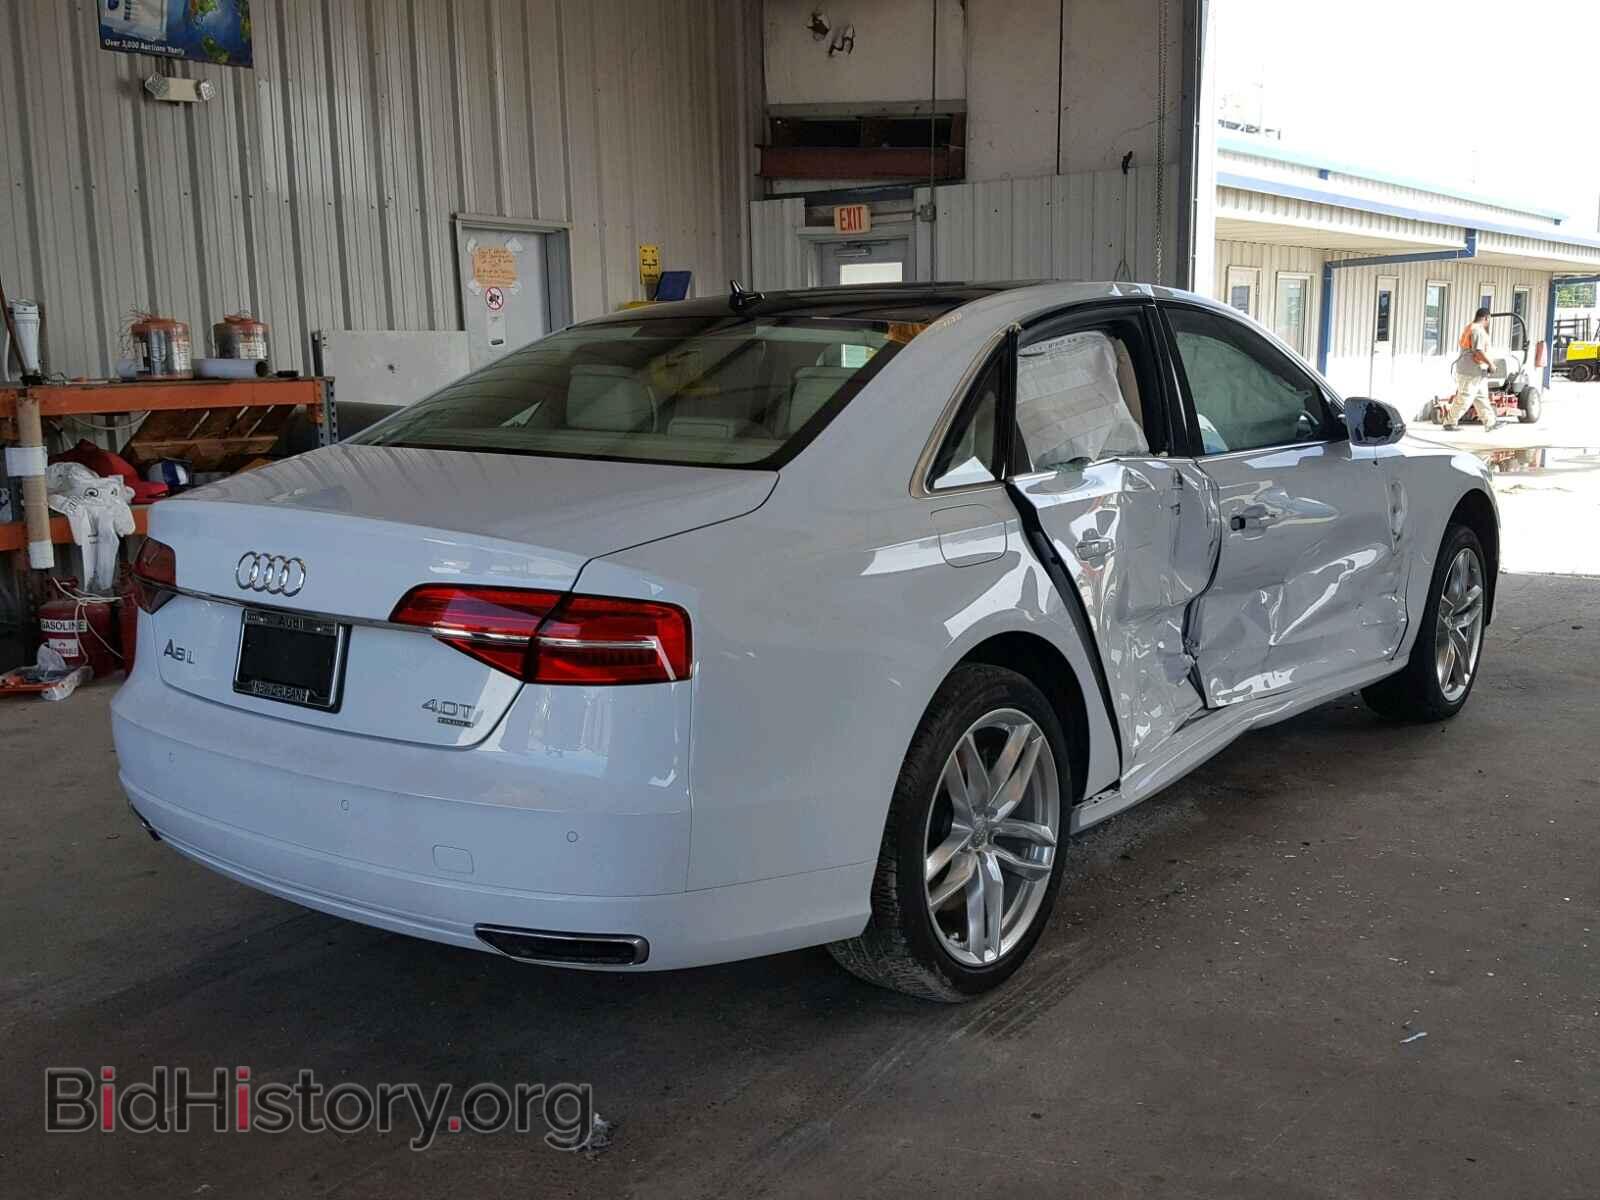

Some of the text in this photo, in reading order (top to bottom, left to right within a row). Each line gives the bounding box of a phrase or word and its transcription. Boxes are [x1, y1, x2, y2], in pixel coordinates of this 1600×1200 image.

[105, 39, 120, 47] Over
[839, 206, 864, 231] EXIT
[42, 621, 85, 630] GASOLINE
